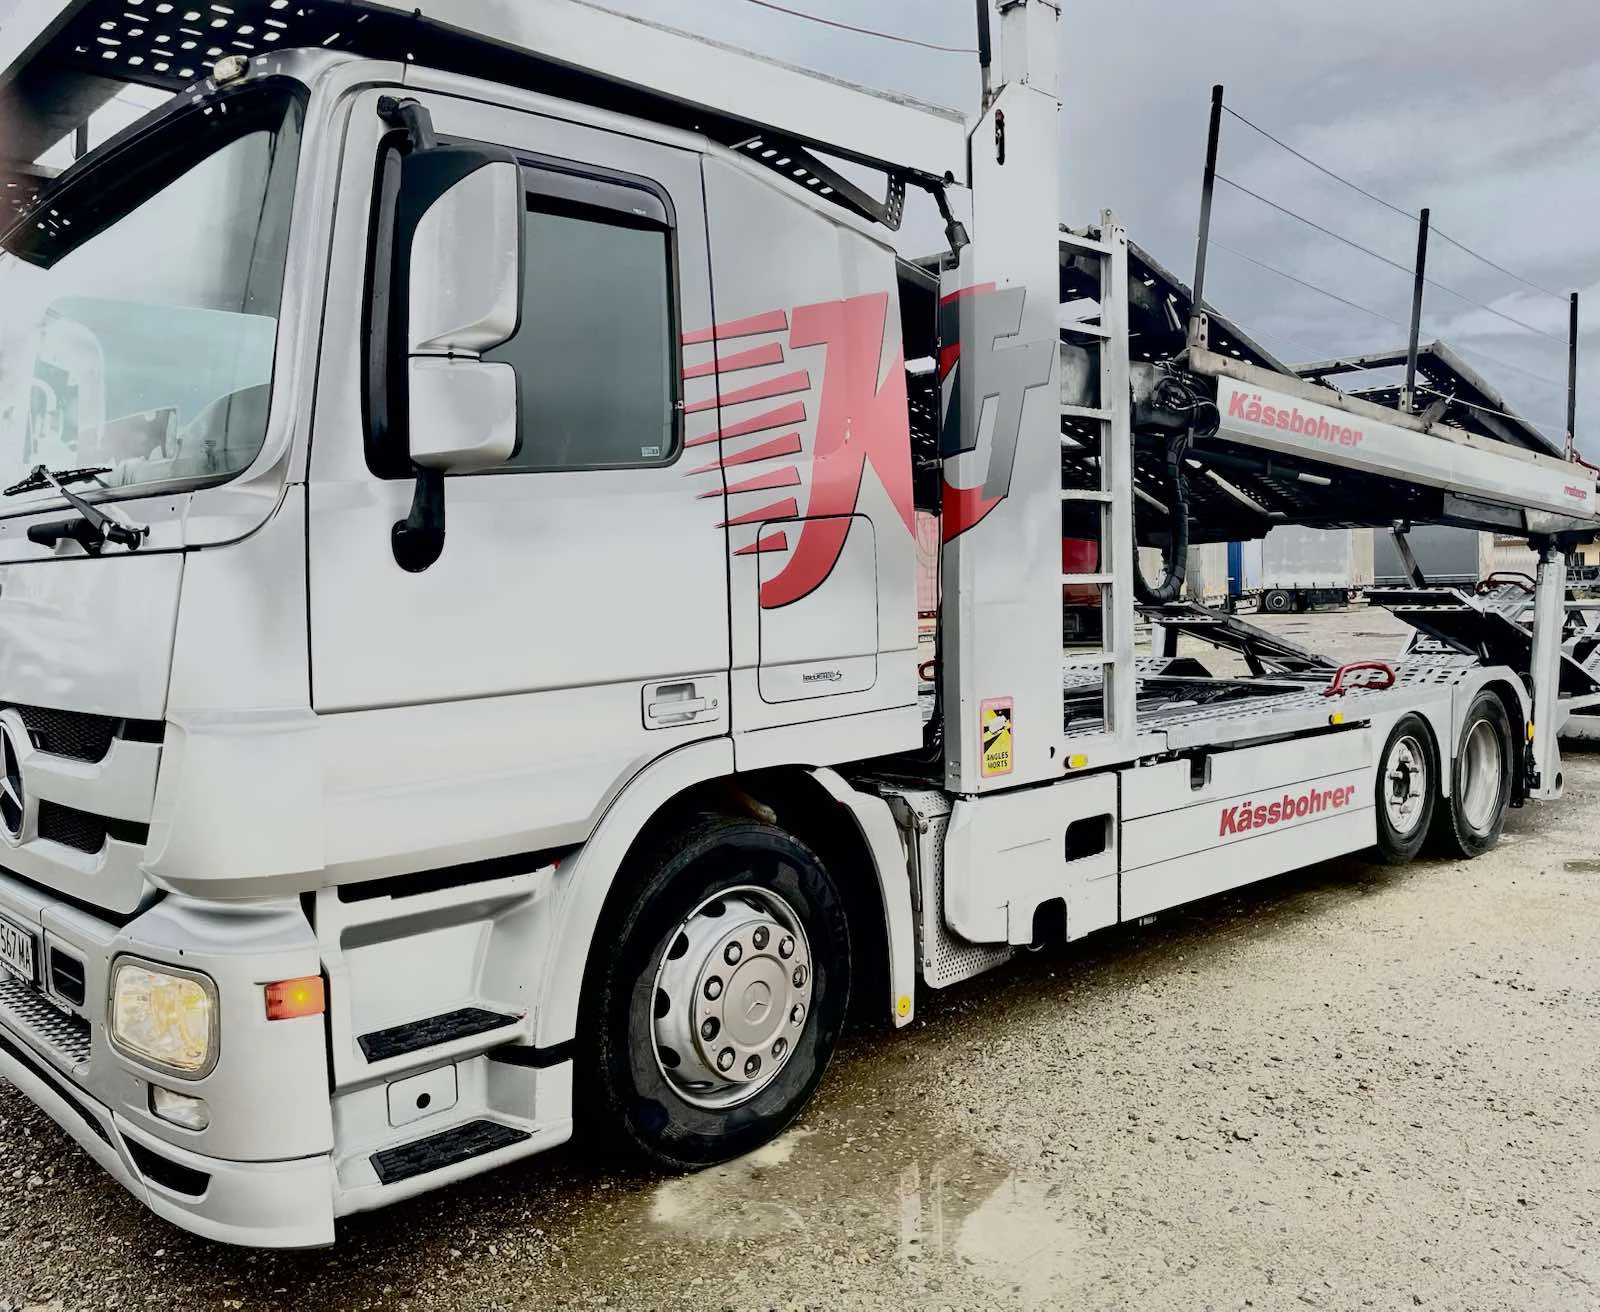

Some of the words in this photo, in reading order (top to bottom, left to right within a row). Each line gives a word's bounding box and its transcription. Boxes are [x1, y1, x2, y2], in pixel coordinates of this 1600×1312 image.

[1228, 391, 1363, 447] Kässbohrer
[986, 751, 1008, 761] ANGLES
[987, 760, 1008, 769] MORTS
[1219, 785, 1355, 836] Kässbohrer
